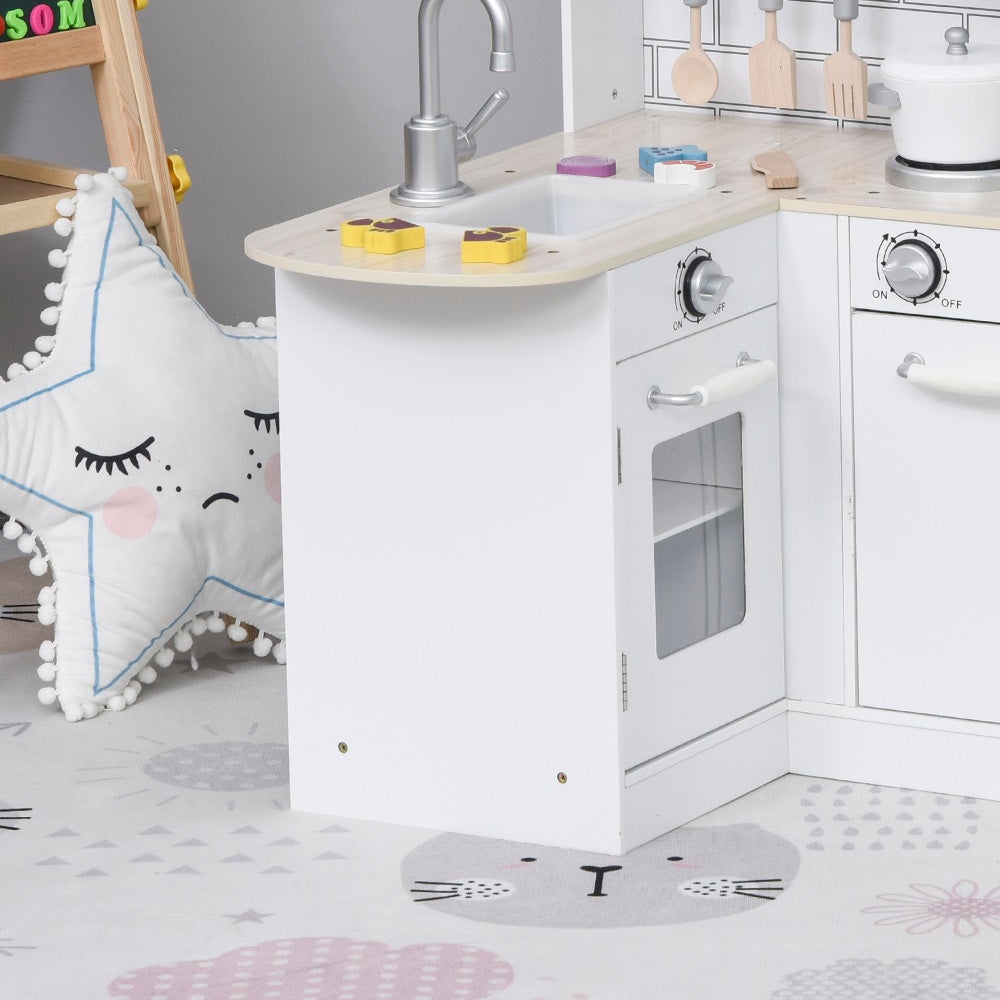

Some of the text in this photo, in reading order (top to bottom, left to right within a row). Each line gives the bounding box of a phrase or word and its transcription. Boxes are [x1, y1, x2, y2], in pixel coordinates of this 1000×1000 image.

[872, 289, 963, 309] ON OFF
[672, 320, 683, 331] ON
